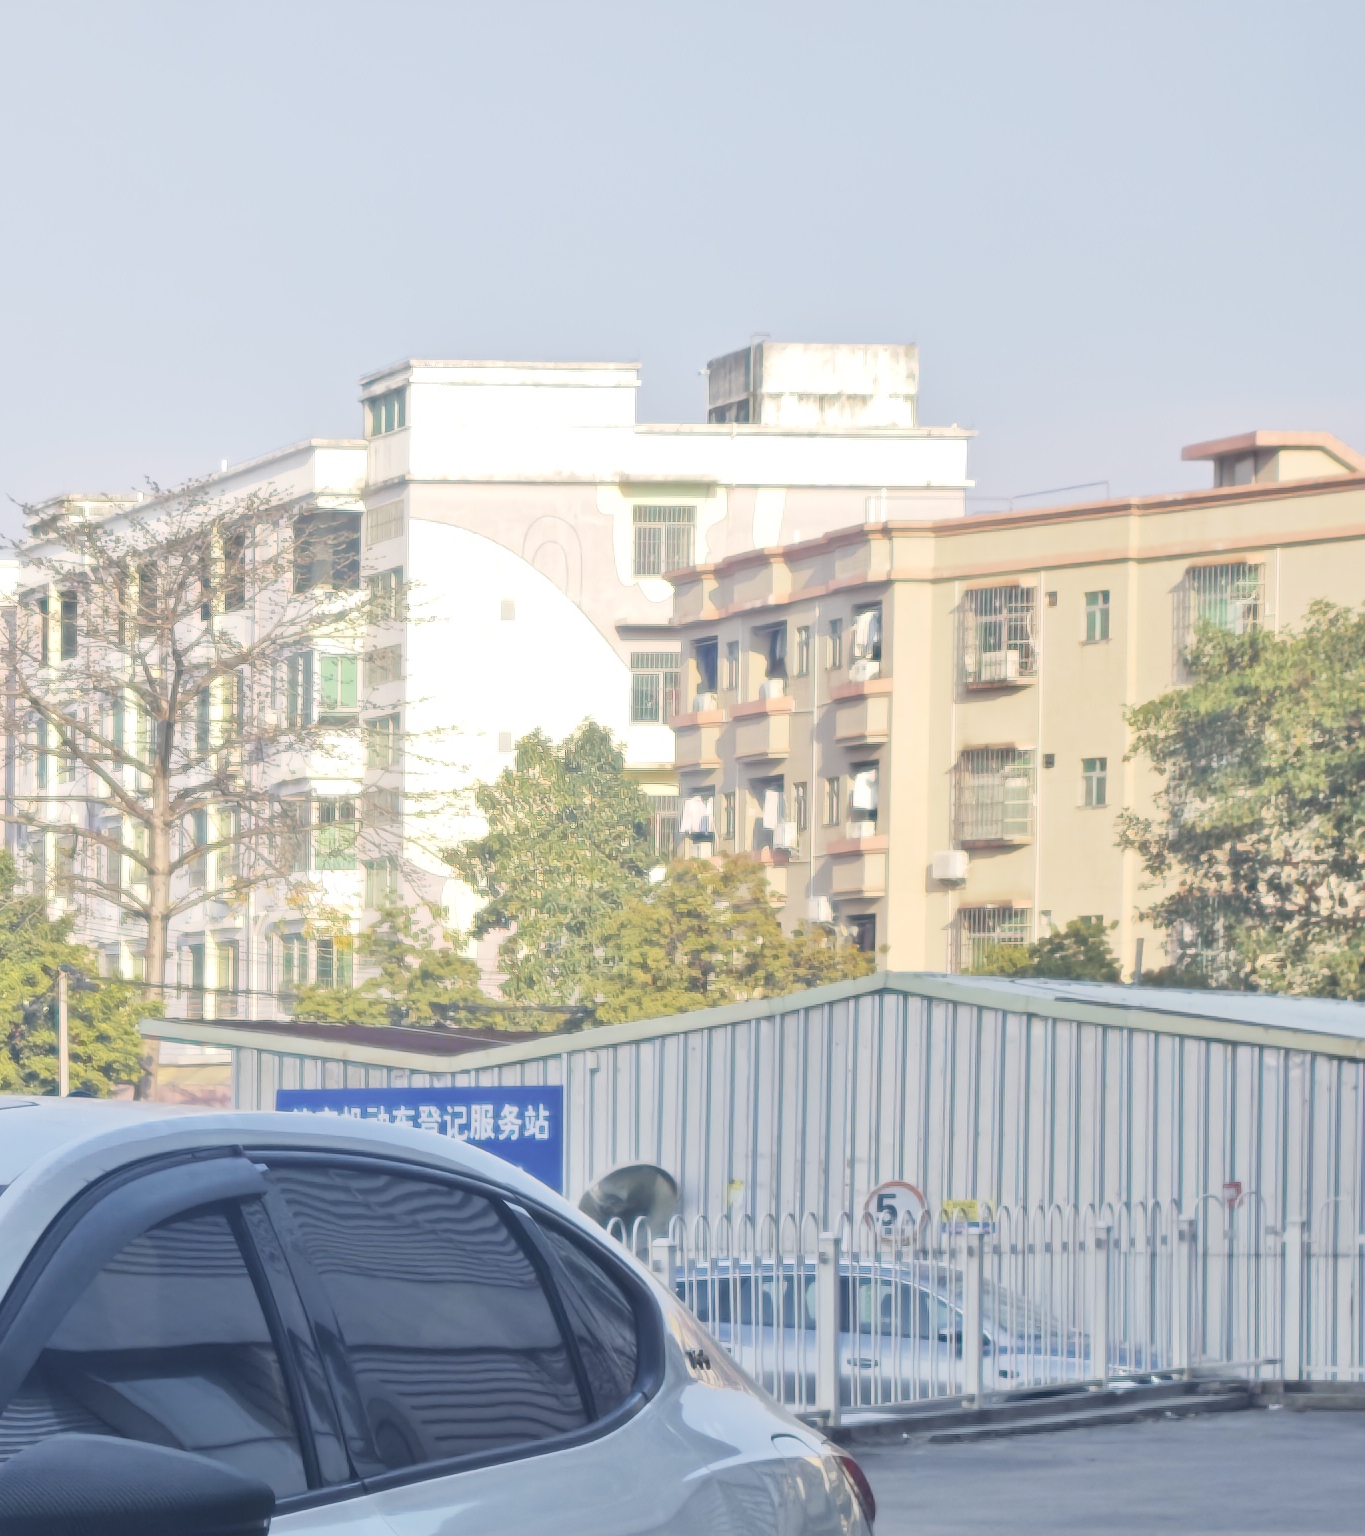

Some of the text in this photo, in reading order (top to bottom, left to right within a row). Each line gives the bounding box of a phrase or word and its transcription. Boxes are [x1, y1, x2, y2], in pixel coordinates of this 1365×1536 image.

[293, 1103, 549, 1140] 车登记服务站
[877, 1193, 898, 1226] 5
